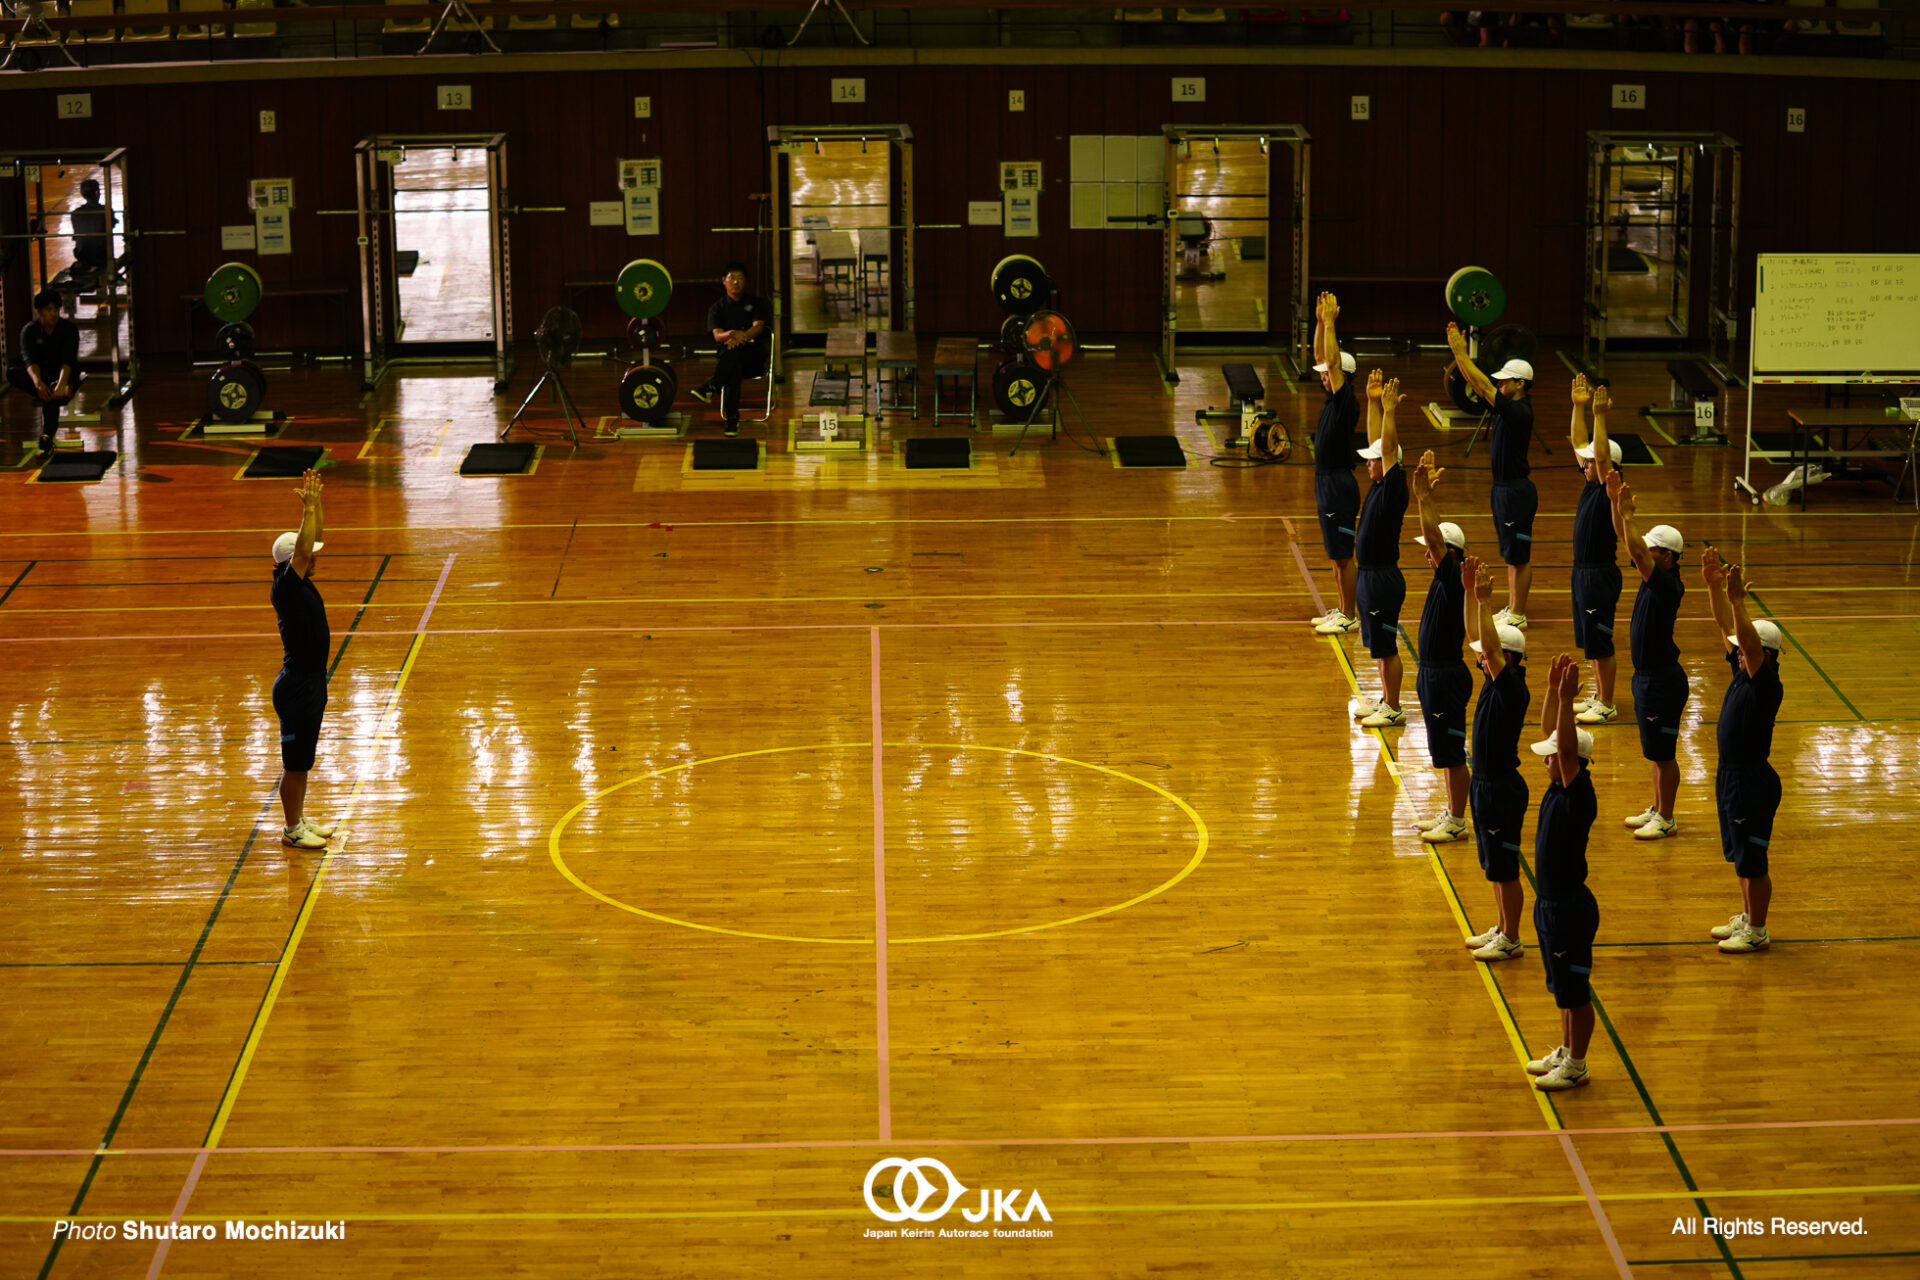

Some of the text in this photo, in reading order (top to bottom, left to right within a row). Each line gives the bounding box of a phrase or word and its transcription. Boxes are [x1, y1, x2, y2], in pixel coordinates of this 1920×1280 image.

[841, 85, 857, 99] 14
[1181, 83, 1196, 96] 15
[1621, 89, 1637, 103] 16
[447, 92, 463, 106] 13
[1011, 95, 1022, 105] 14
[66, 100, 82, 114] 12
[637, 102, 649, 112] 13
[1353, 102, 1367, 114] 15
[262, 115, 273, 126] 12
[1790, 114, 1804, 126] 16
[1697, 406, 1712, 419] 16
[822, 418, 837, 431] 15
